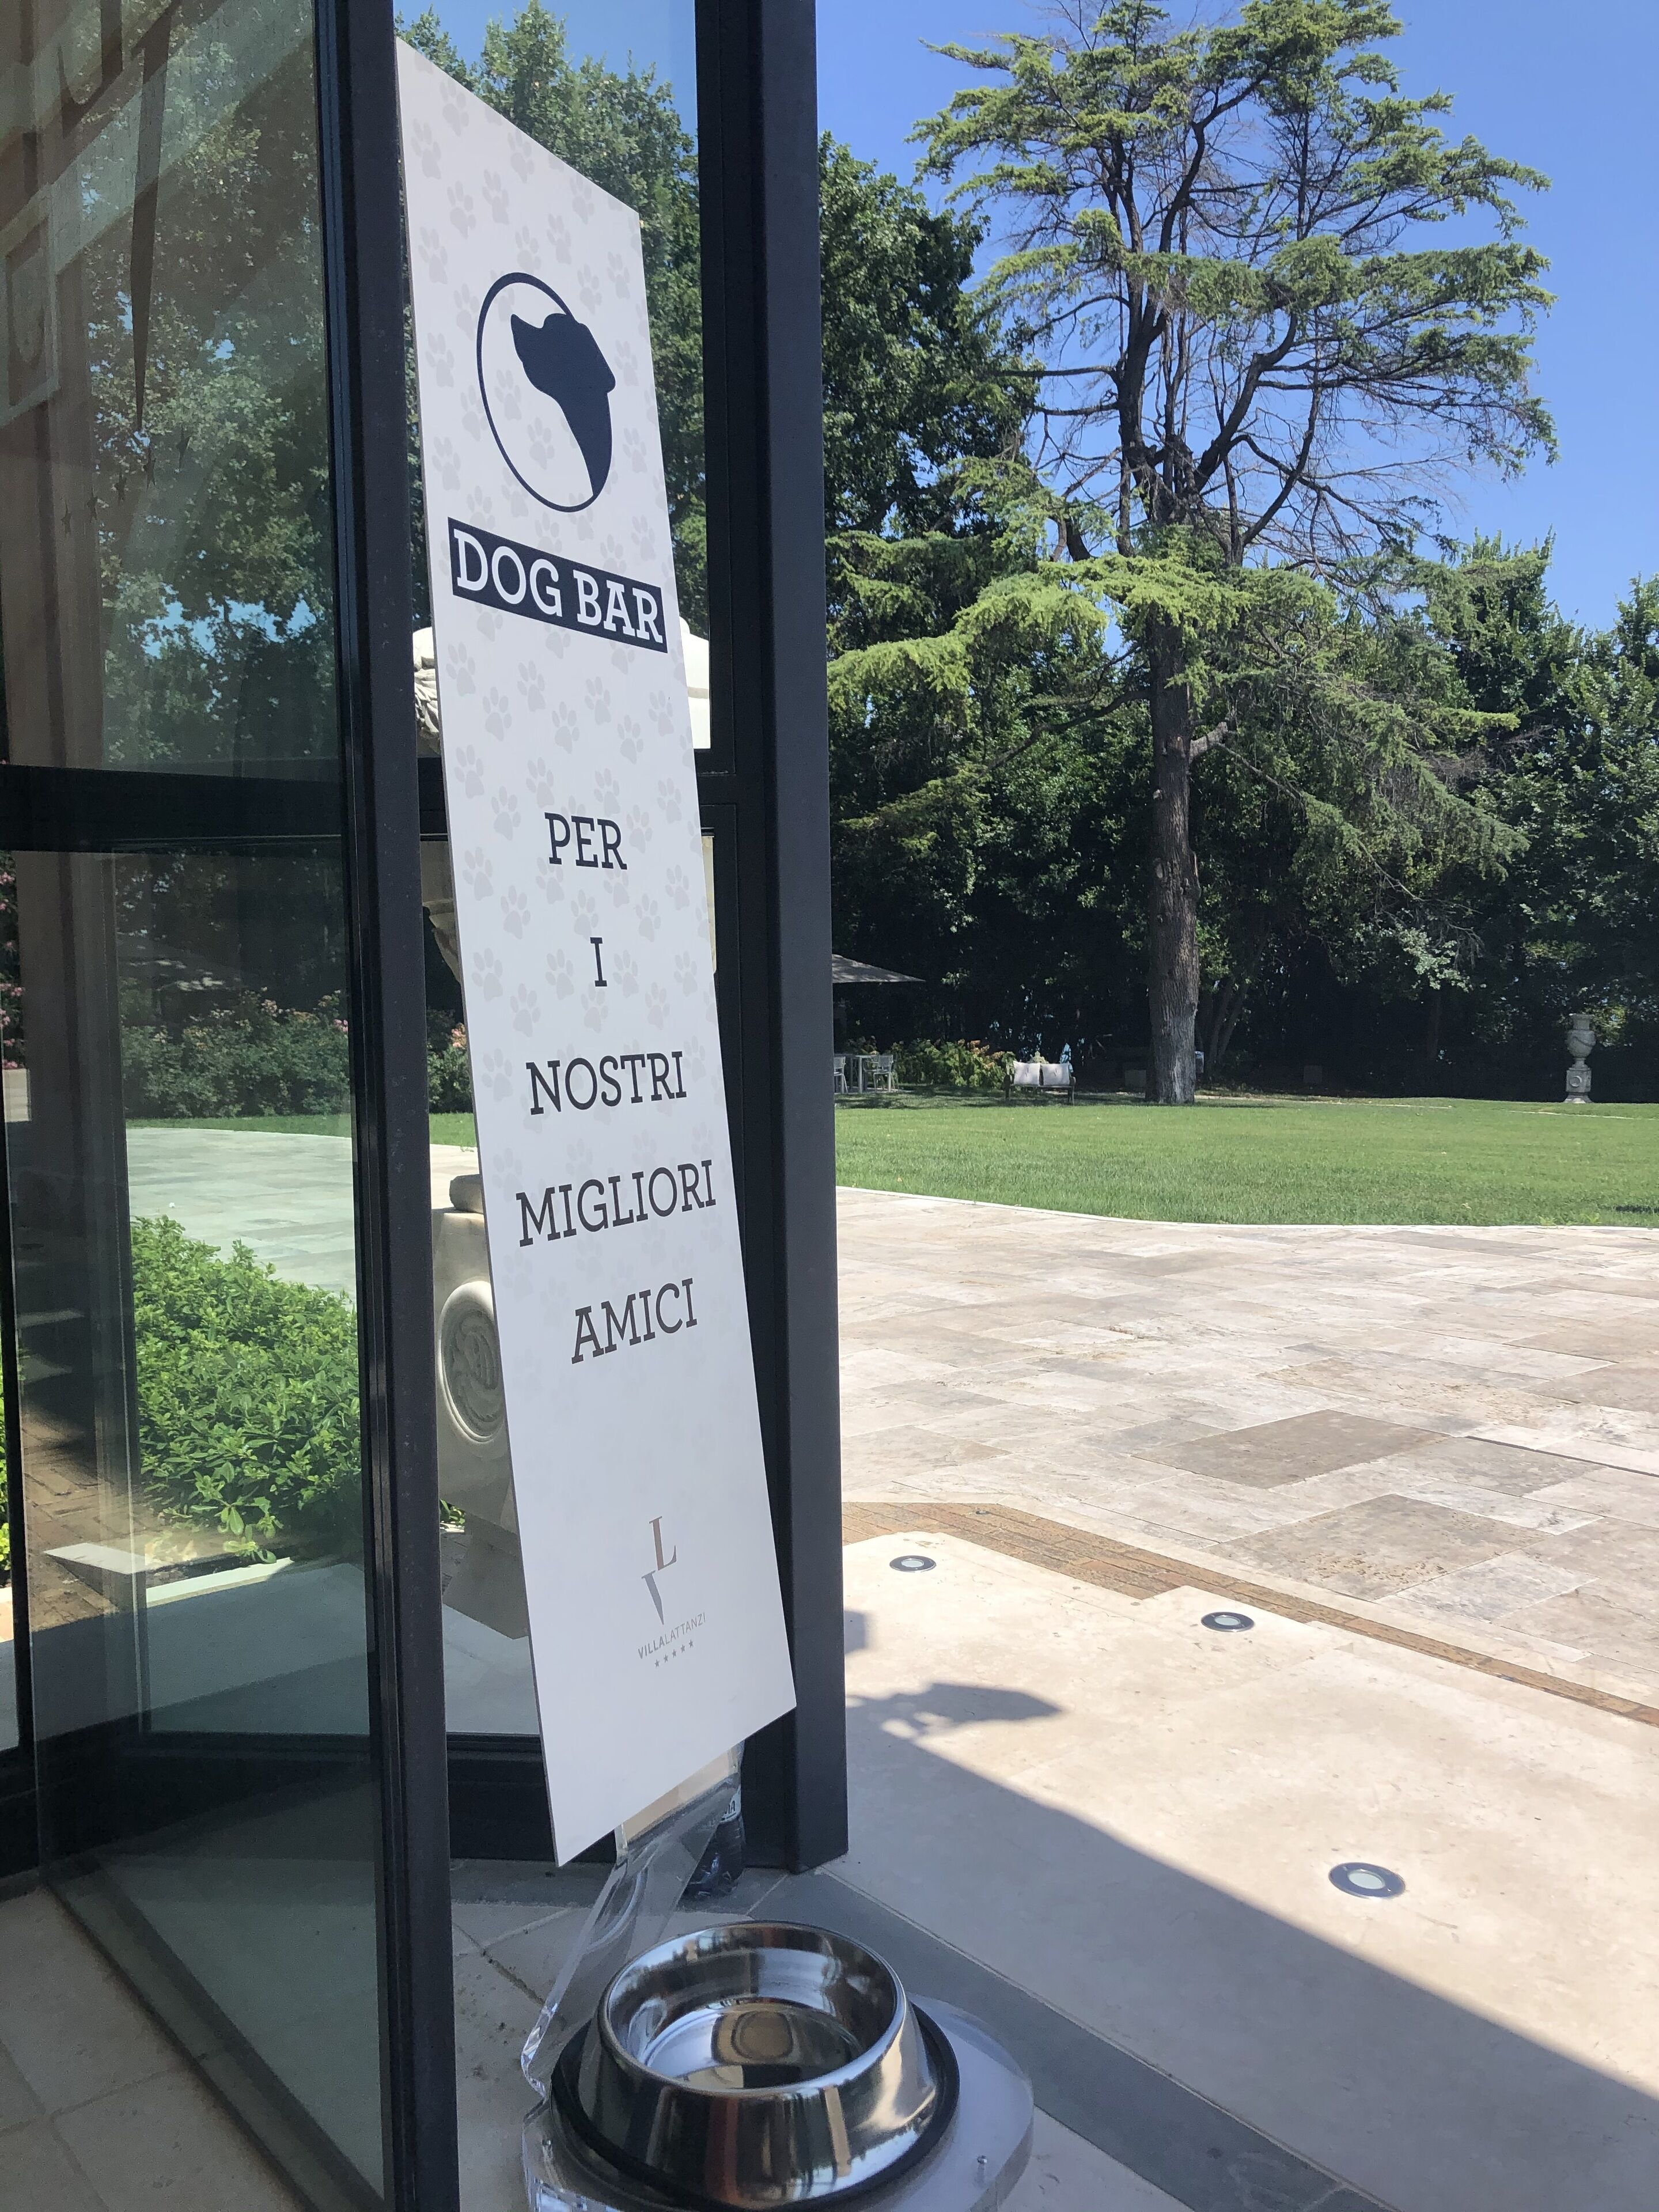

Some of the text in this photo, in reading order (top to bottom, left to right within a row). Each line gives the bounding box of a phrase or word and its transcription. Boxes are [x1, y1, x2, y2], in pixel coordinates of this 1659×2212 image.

[453, 528, 663, 644] DOG BAR
[544, 812, 628, 870] PER
[590, 937, 608, 987] I
[525, 1051, 687, 1115] NOSTRI
[515, 1159, 717, 1247] MIGLIORI
[571, 1277, 698, 1365] AMICI
